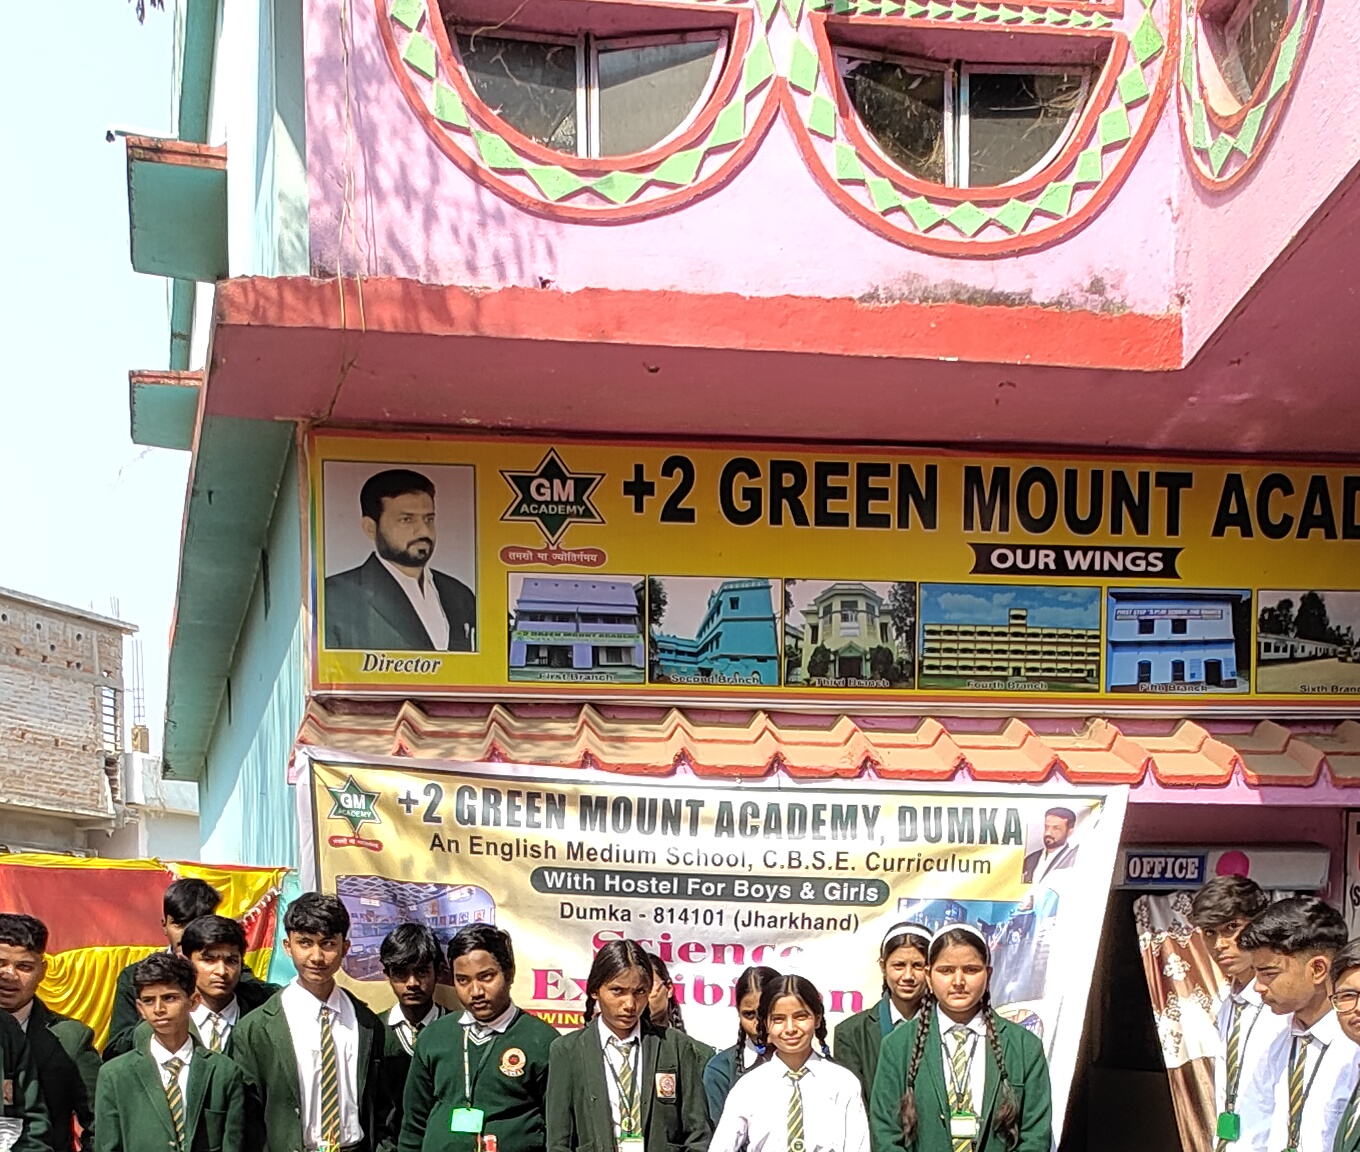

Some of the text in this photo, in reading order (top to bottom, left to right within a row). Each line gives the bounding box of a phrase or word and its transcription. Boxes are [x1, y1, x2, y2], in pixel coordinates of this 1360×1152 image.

[530, 479, 575, 502] GM
[623, 455, 696, 523] +2
[720, 457, 938, 531] GREEN
[963, 464, 1193, 537] MOUNT
[519, 503, 586, 516] ACADEMY
[990, 548, 1164, 572] OUR WINGS
[362, 653, 441, 673] Director
[570, 671, 615, 681] Branch
[670, 673, 760, 684] Second Branch
[815, 677, 890, 688] Third Branch
[966, 680, 1048, 690] Fourth Branch
[1139, 682, 1209, 693] Fifth Branch
[1299, 684, 1329, 694] Sixth
[340, 793, 366, 809] GM
[398, 783, 1023, 846] +2 GREEN MOUNT ACADEMY, DUMKA
[429, 832, 992, 874] An English Medium School, C.B.S.E. Curriculum
[1128, 856, 1199, 881] OFFICE
[543, 871, 879, 903] With Hostel For Boys & Girls
[560, 902, 632, 922] Dumka
[653, 907, 725, 927] 814101
[733, 909, 859, 934] (Jharkhand)
